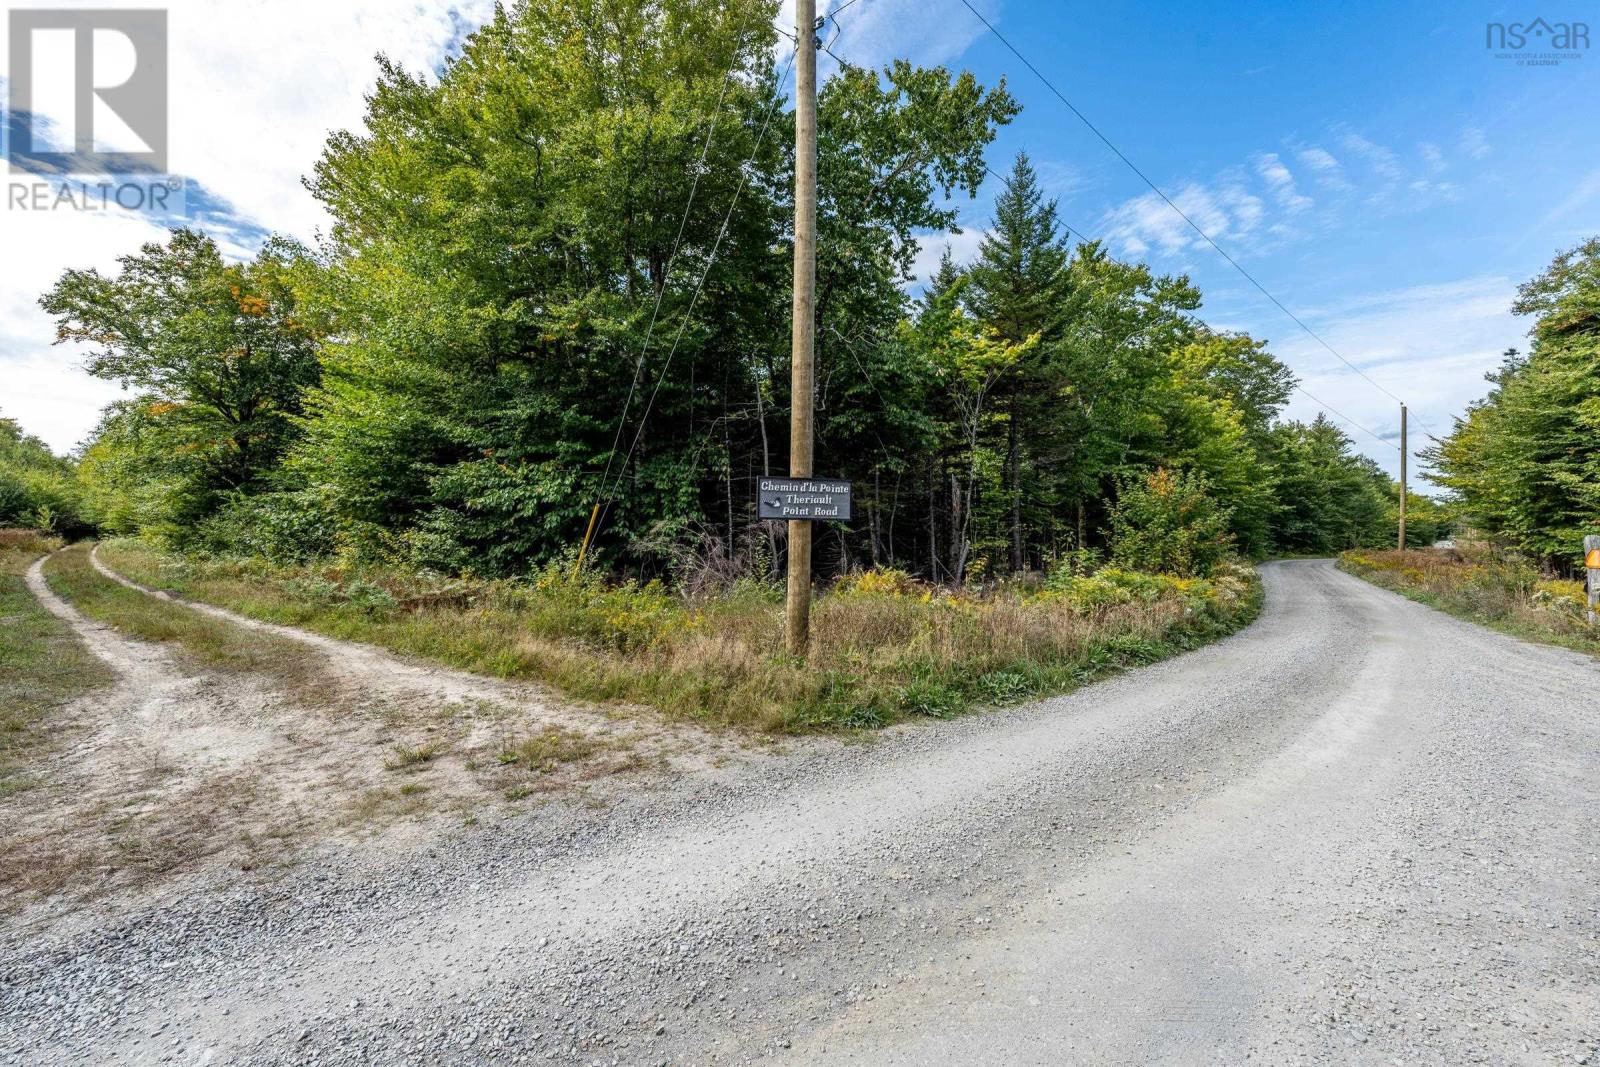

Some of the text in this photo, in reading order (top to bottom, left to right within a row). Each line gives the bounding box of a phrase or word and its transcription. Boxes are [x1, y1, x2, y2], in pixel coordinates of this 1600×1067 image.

[761, 481, 849, 493] Chemin d'la Pointe
[786, 494, 832, 505] Theriault
[782, 506, 838, 516] Point Road
